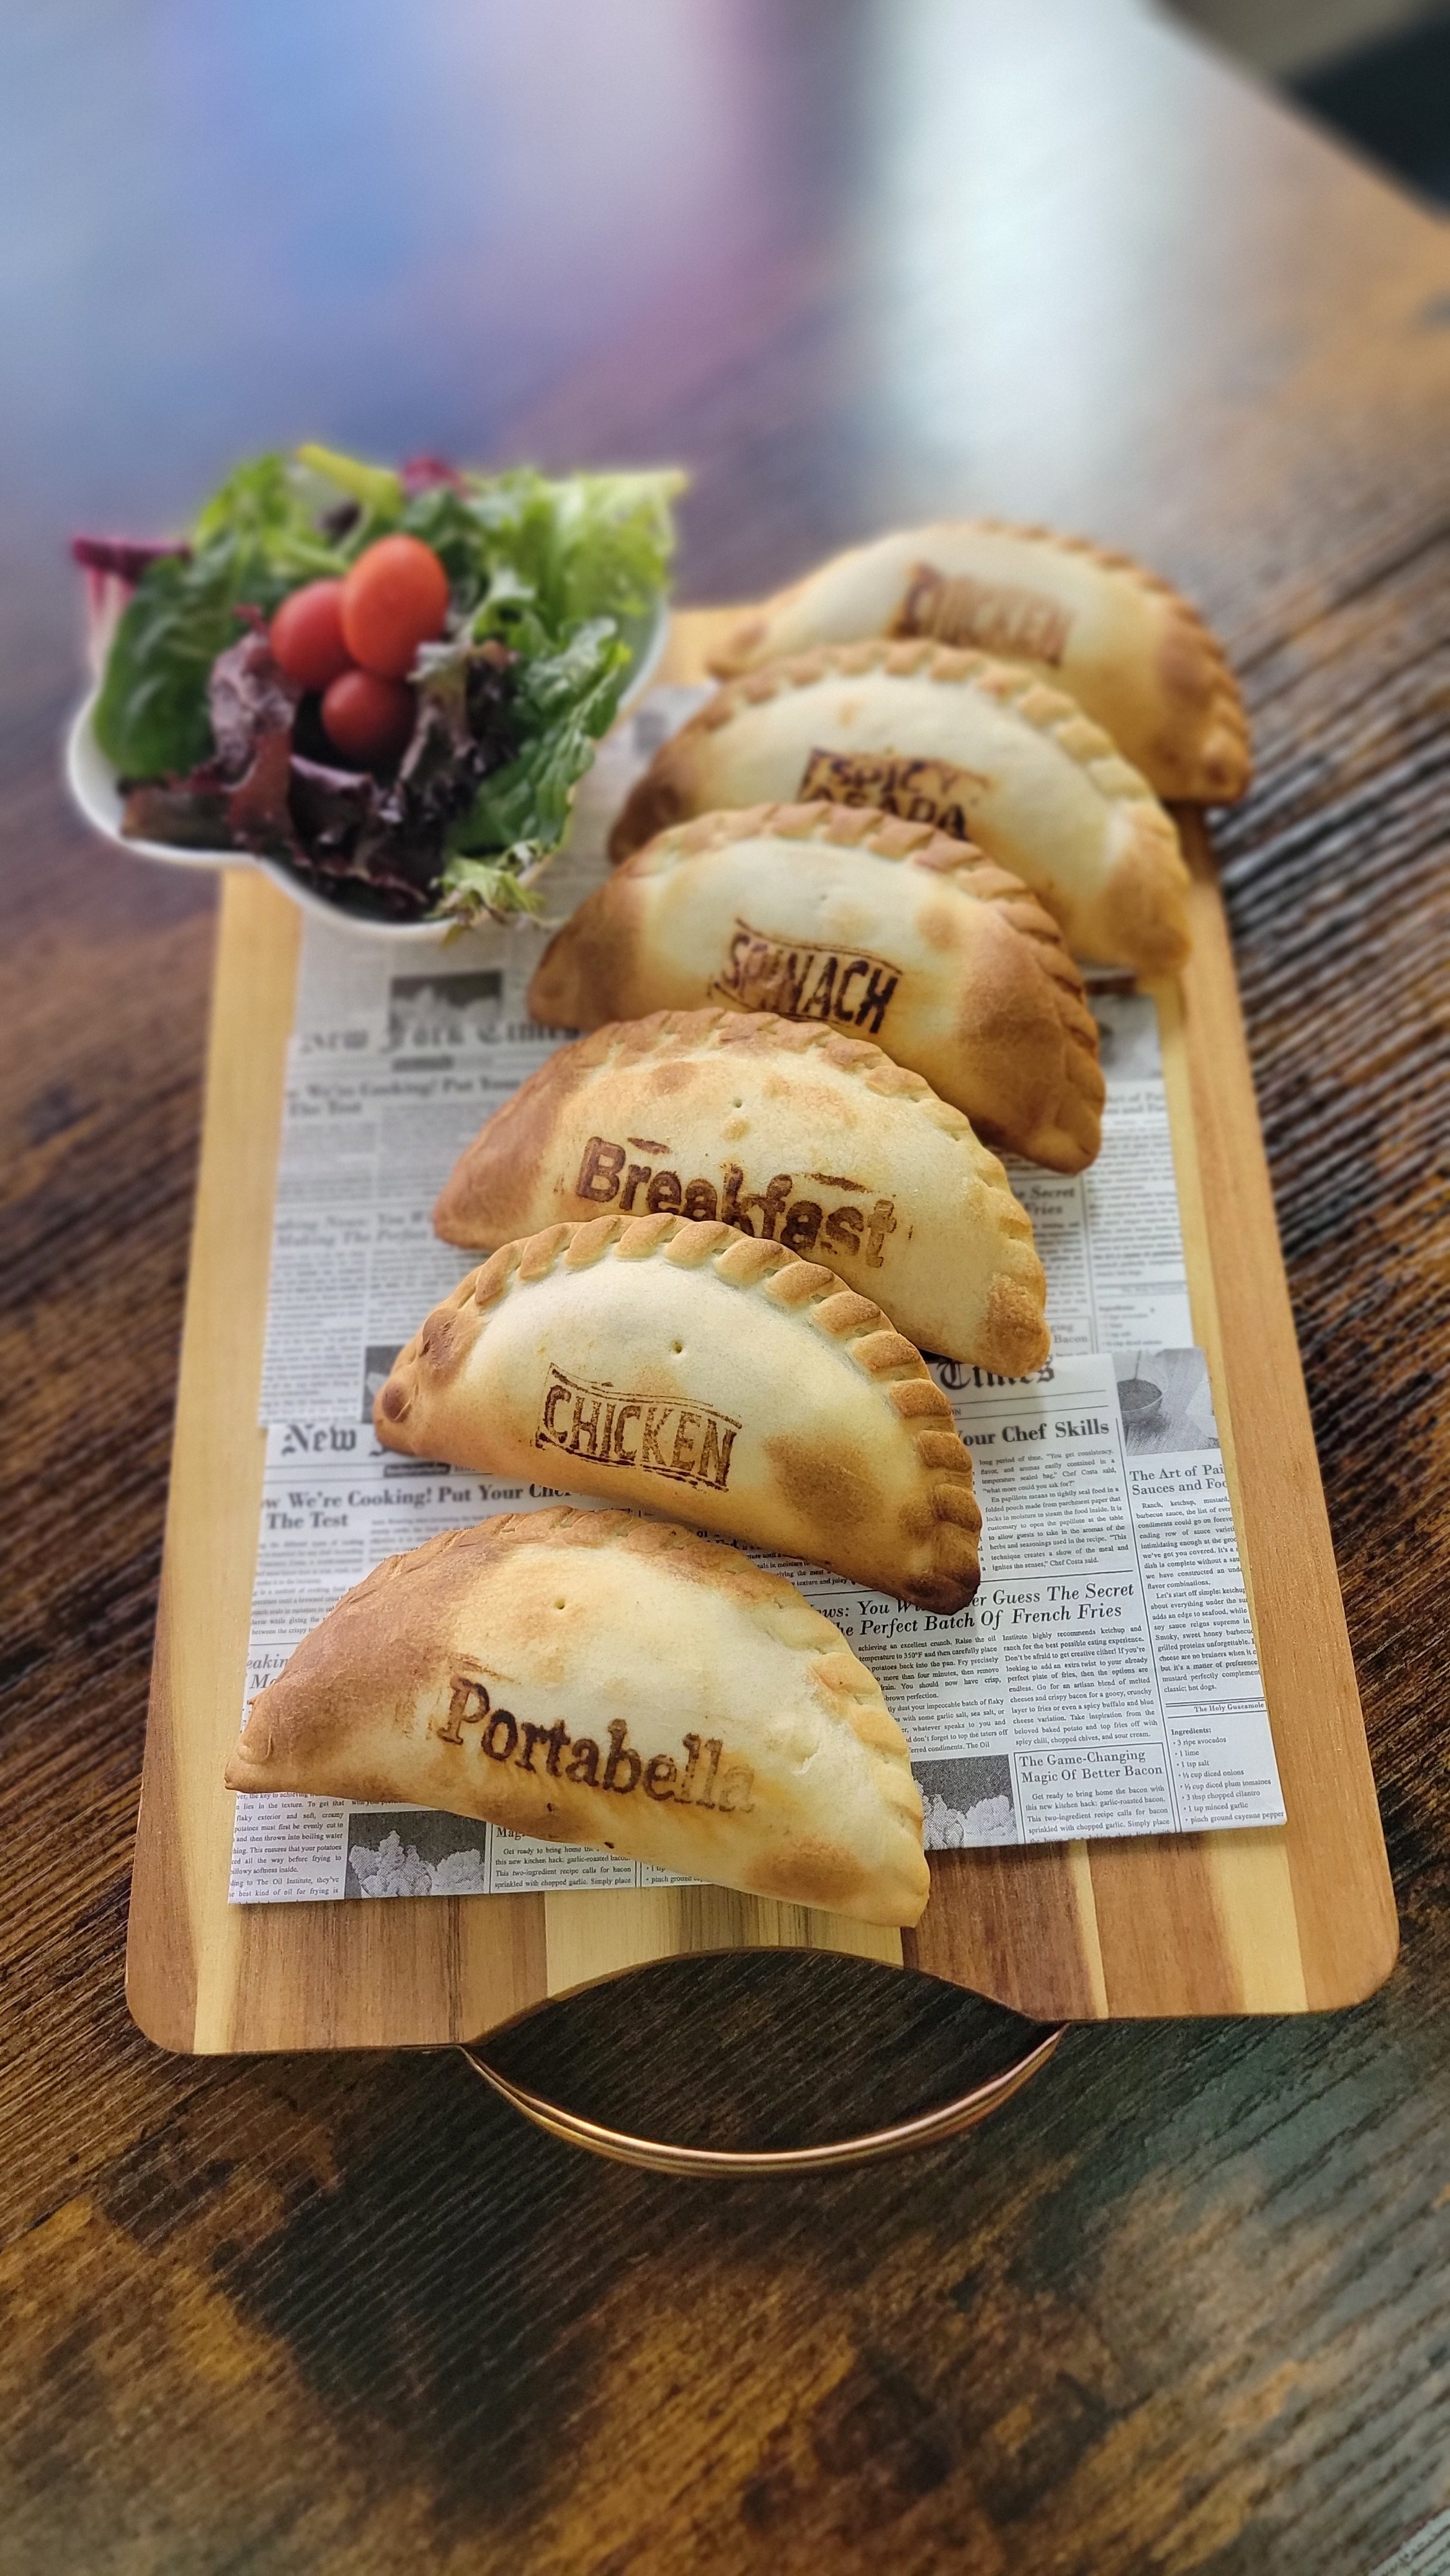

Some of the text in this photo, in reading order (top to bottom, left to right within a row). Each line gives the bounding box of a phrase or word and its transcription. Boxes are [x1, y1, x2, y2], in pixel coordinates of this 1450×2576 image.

[722, 933, 898, 1034] SPINACH
[1030, 1186, 1075, 1199] Secret
[577, 1136, 897, 1267] Breakfast
[1054, 1335, 1088, 1344] Bacon
[544, 1385, 737, 1486] CHICKEN
[957, 1419, 1109, 1446] our Chef Skills
[281, 1425, 357, 1457] New
[1129, 1470, 1155, 1481] The
[1158, 1467, 1181, 1479] Art
[1184, 1466, 1198, 1477] of
[1132, 1484, 1175, 1495] Sauces
[1178, 1480, 1202, 1491] and
[288, 1491, 342, 1508] We're
[348, 1489, 432, 1510] Cooking!
[438, 1487, 471, 1502] Put
[478, 1485, 525, 1502] Your
[267, 1512, 348, 1530] The Test
[992, 1589, 1040, 1605] Guess
[1047, 1586, 1079, 1601] The
[1084, 1583, 1134, 1599] Secret
[838, 1603, 1122, 1638] he Perfect Batch Of French Fries
[1032, 1631, 1052, 1640] highly
[1057, 1629, 1096, 1637] recommends
[1171, 1727, 1211, 1737] Ingredients:
[437, 1677, 755, 1813] Portabella
[1183, 1739, 1196, 1747] ripe
[1019, 1750, 1145, 1766] The Game-Changing
[1187, 1761, 1196, 1769] tsp
[1021, 1766, 1162, 1785] Magic Of Better Bacon
[1224, 1781, 1241, 1789] plum
[1046, 1792, 1064, 1800] ready
[1075, 1790, 1093, 1798] bring
[1207, 1792, 1234, 1801] chopped
[1100, 1797, 1143, 1808] garlic-roasted
[1230, 1802, 1248, 1811] garlic
[1044, 1812, 1091, 1822] two-ingredient
[1094, 1810, 1114, 1819] recipe
[1191, 1815, 1209, 1824] pinch
[1210, 1814, 1233, 1823] ground
[1028, 1825, 1058, 1835] sprinkled
[1076, 1822, 1103, 1832] chopped
[1105, 1821, 1125, 1830] garlic.
[1127, 1819, 1151, 1828] Simply
[1153, 1818, 1170, 1827] place
[317, 1877, 339, 1886] they've
[310, 1888, 329, 1896] frying
